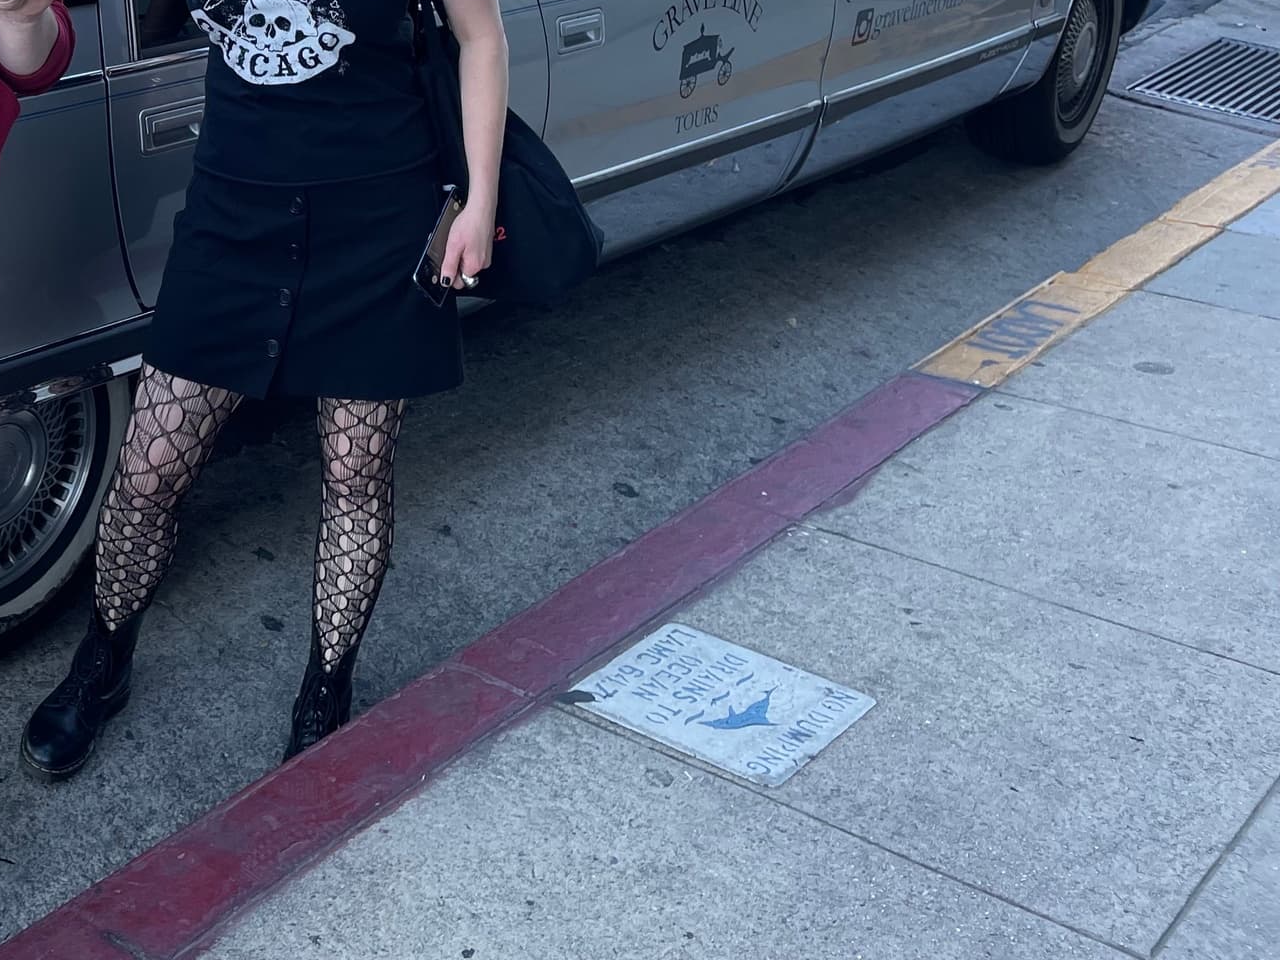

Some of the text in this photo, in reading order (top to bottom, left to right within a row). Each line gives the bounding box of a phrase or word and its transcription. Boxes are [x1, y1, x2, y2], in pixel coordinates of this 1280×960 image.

[197, 18, 339, 77] CHICAGO
[675, 104, 720, 134] TOURS
[637, 629, 697, 665] LAMC
[632, 655, 703, 701] OCEAN
[646, 653, 749, 725] DRAINS TO
[746, 689, 858, 775] NO DUMPING
